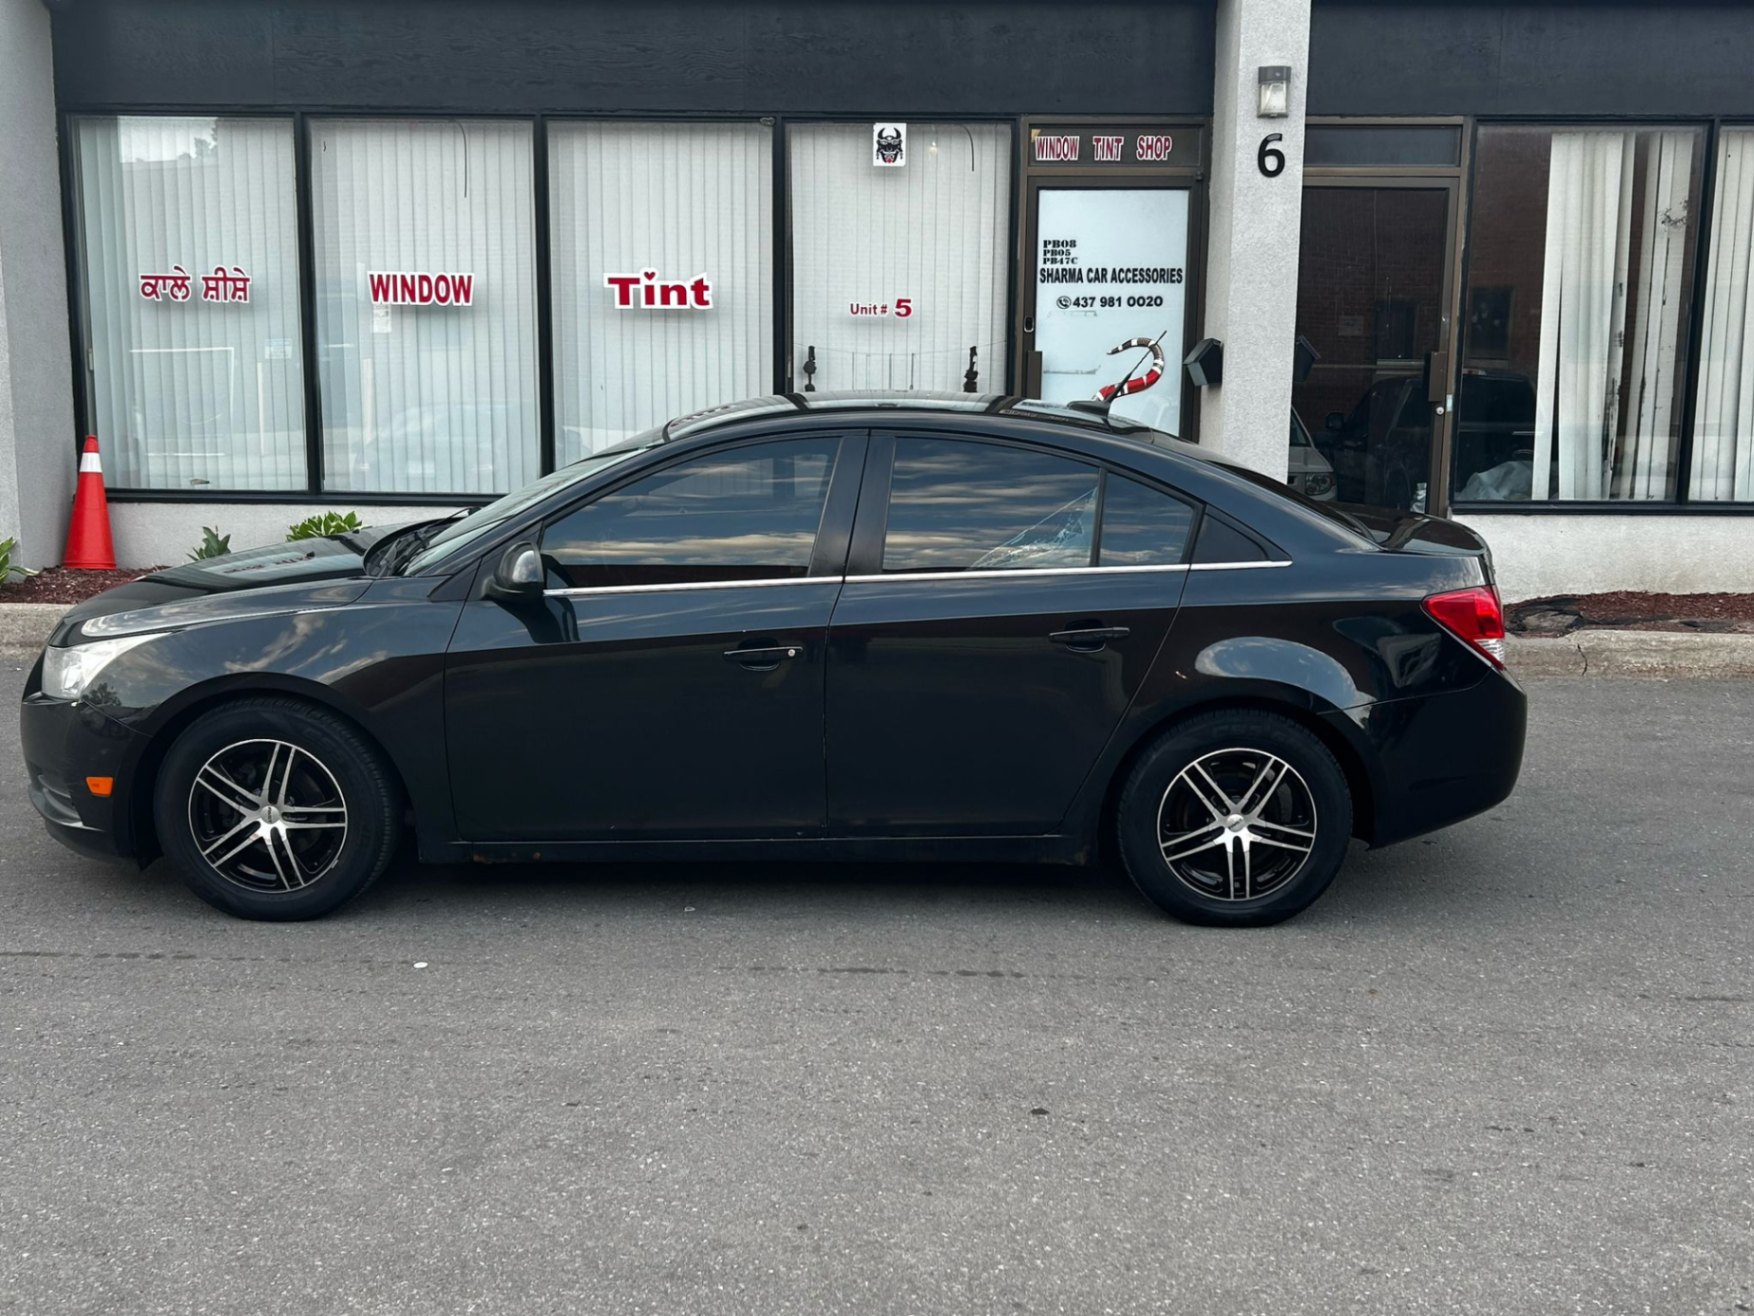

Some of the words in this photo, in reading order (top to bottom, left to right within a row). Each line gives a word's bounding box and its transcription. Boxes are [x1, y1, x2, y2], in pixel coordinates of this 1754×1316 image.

[1035, 136, 1079, 161] WINDOW
[1093, 136, 1124, 161] TINT
[1137, 135, 1172, 161] SHOP
[1257, 133, 1285, 178] 6
[1043, 239, 1077, 248] PB08
[140, 265, 191, 300] ਕਾਲੇ
[607, 270, 710, 306] Tint
[1039, 267, 1084, 284] SHARMA
[1086, 267, 1108, 284] CAR
[1110, 267, 1183, 284] ACCESSORIES
[369, 273, 473, 305] WINDOW
[1072, 296, 1096, 308] 437
[1099, 296, 1122, 308] 981
[1126, 295, 1164, 308] 0020
[850, 303, 878, 316] Unit
[880, 303, 888, 315] #
[894, 298, 912, 318] 5
